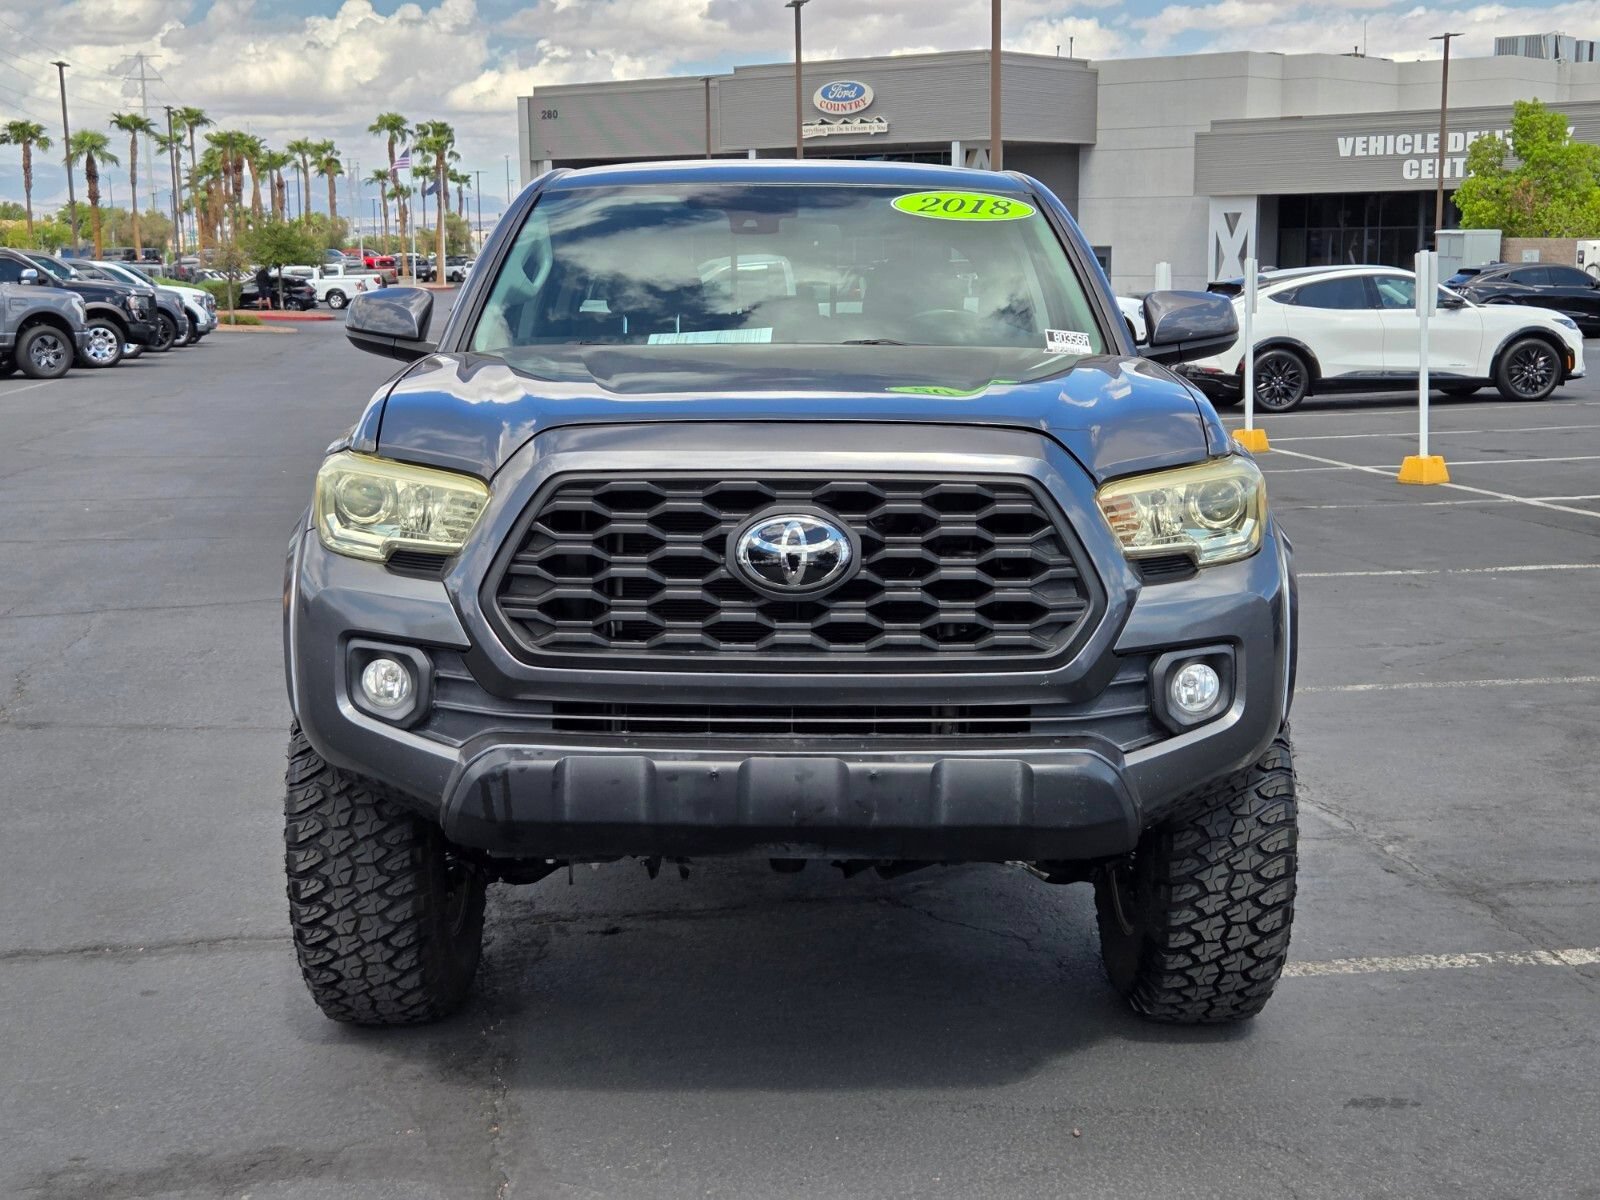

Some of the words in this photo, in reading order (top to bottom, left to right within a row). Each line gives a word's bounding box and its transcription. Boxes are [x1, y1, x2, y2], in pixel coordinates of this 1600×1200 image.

[828, 83, 858, 99] Ford
[820, 97, 867, 112] COUNTRY
[541, 109, 558, 120] 280
[1337, 132, 1439, 157] VEHICLE
[917, 197, 1012, 216] 2018
